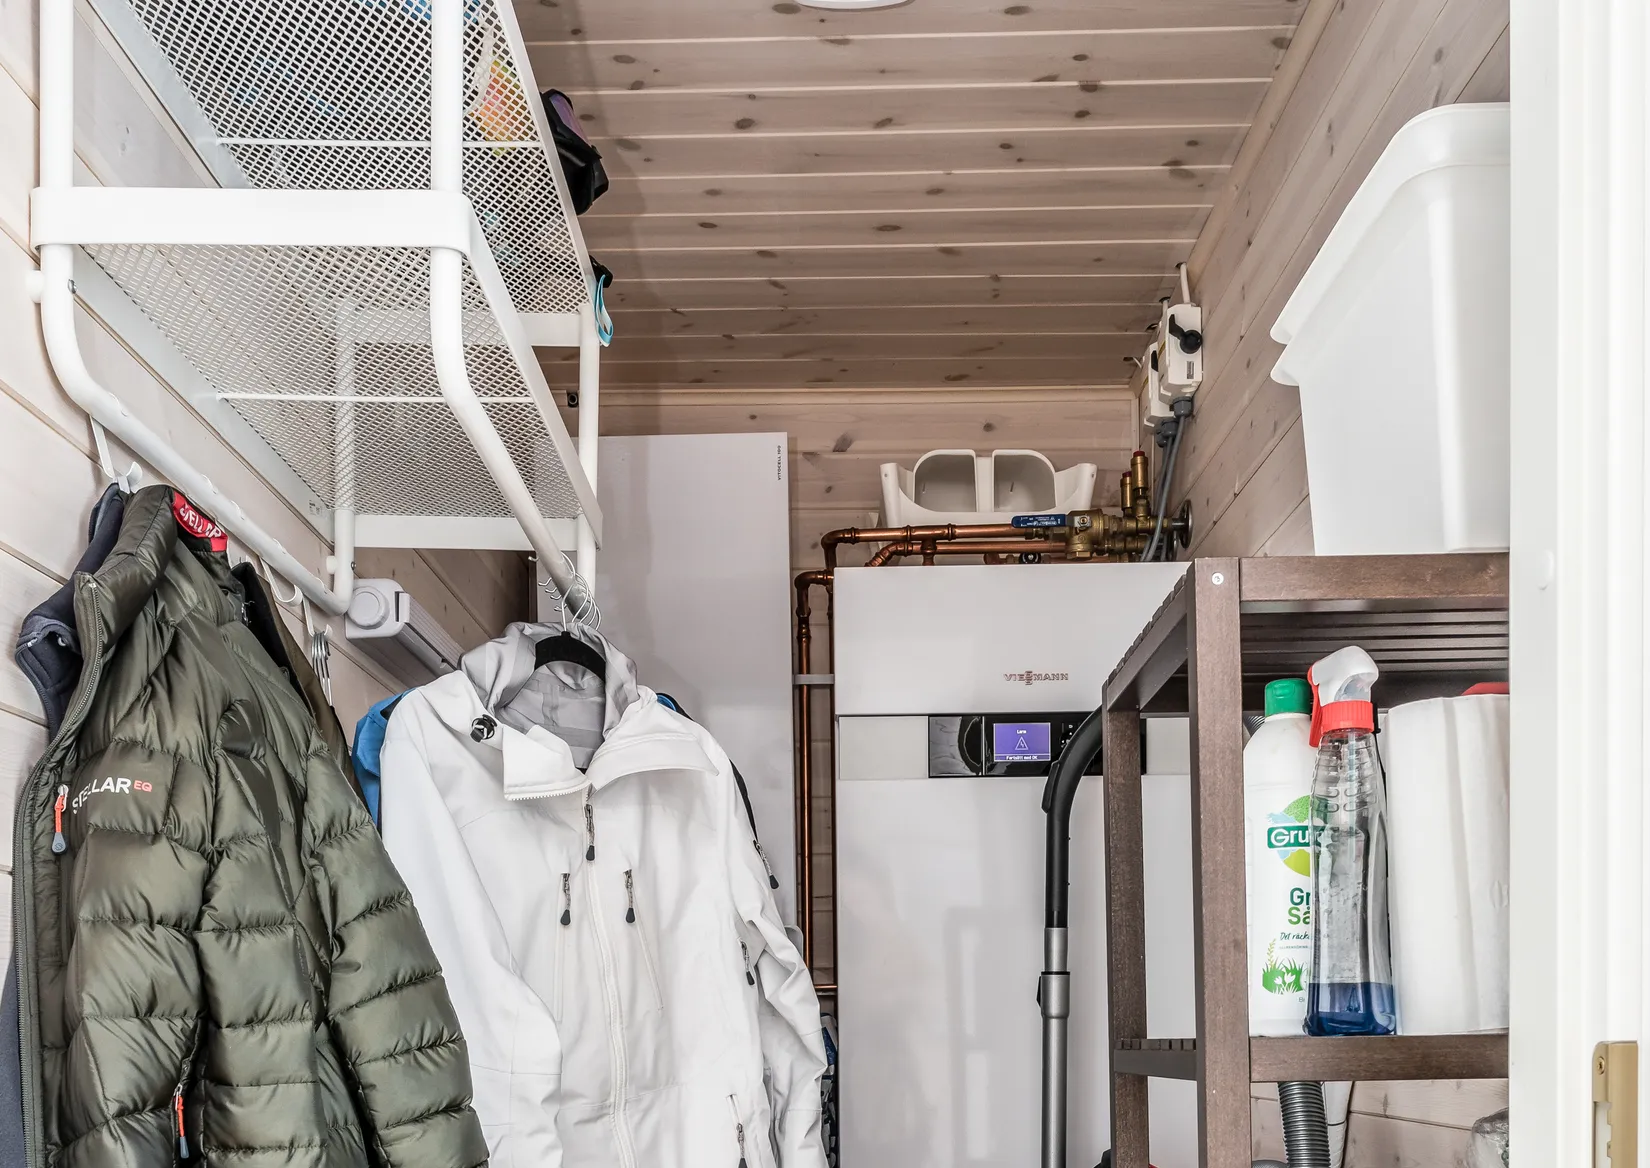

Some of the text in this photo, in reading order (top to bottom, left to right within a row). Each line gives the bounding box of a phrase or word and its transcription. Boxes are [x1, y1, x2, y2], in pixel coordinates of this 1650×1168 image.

[133, 779, 153, 793] EQ
[1270, 828, 1310, 847] Gru
[1290, 887, 1311, 906] Gr
